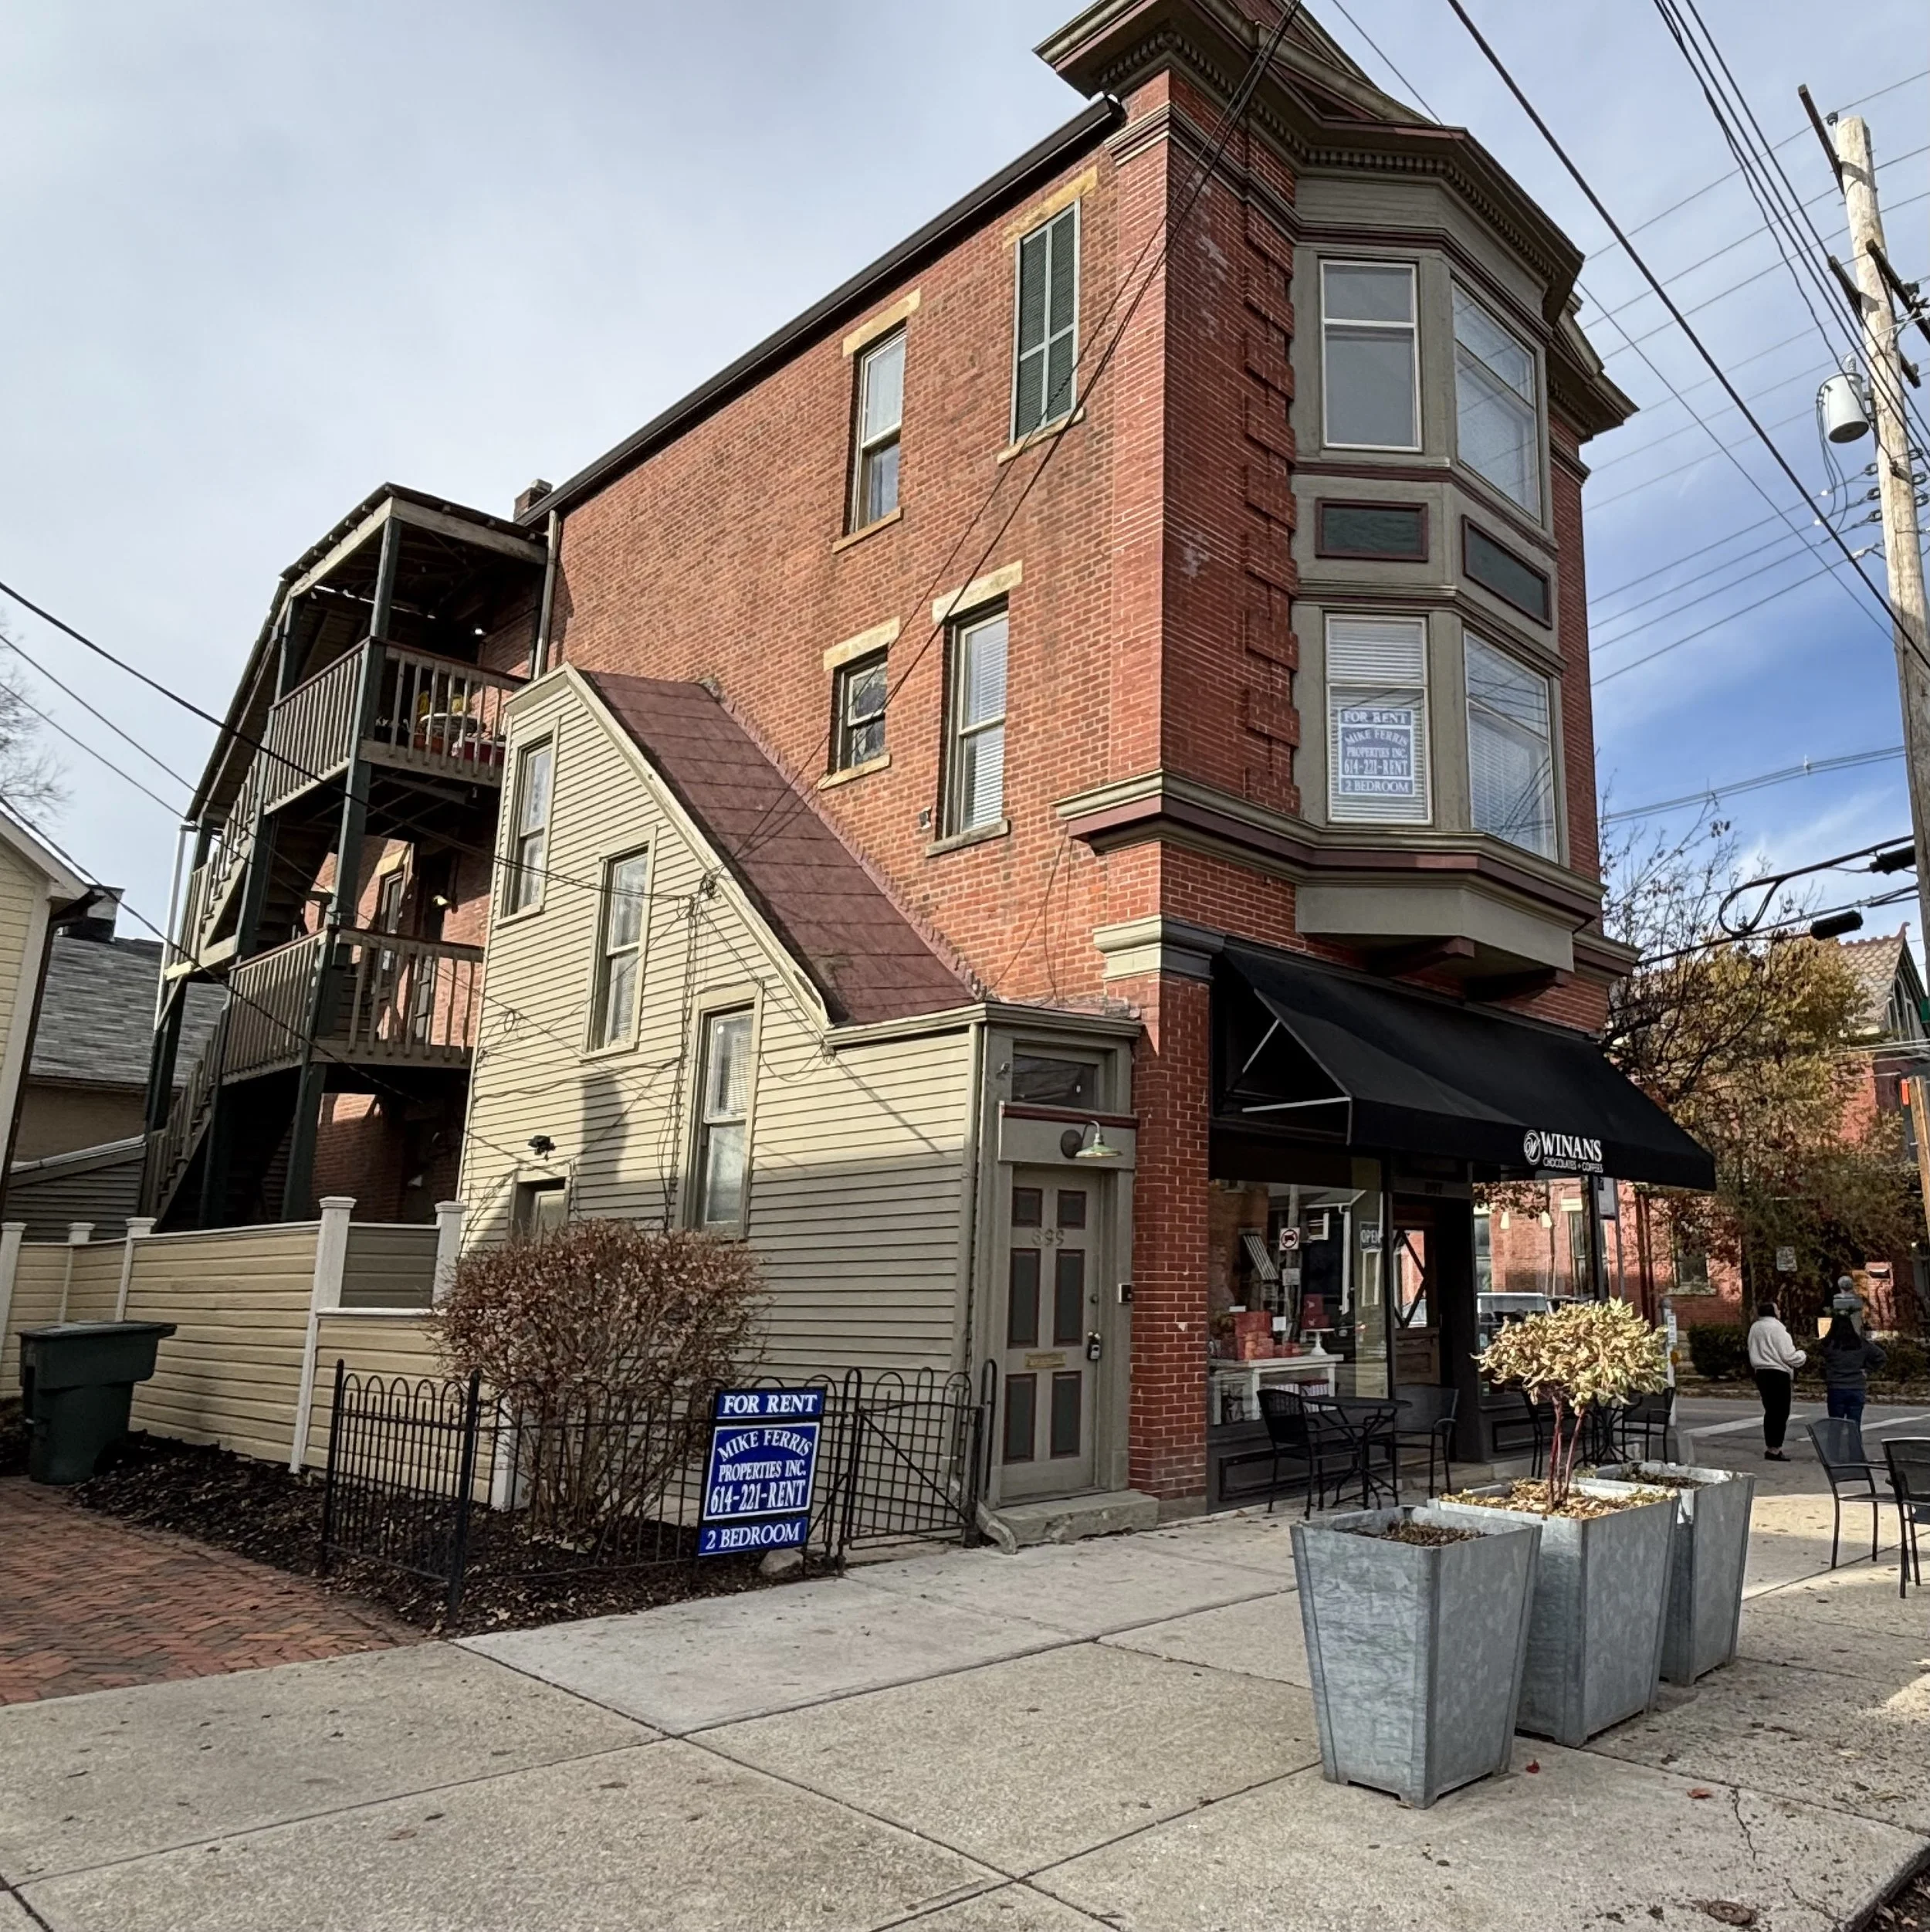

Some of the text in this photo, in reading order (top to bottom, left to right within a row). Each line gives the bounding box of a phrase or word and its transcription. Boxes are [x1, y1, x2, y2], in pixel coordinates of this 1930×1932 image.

[1343, 710, 1407, 724] FOR RENT
[1345, 730, 1408, 746] MIKE FERRIS
[1347, 747, 1407, 758] PROPERTIES INC.
[1344, 759, 1408, 775] 614-221-RENT
[1345, 780, 1409, 792] 2 BEDROOM
[1540, 1131, 1602, 1162] WINANS
[1361, 1229, 1381, 1244] OPEN
[723, 1394, 818, 1414] FOR RENT
[717, 1429, 813, 1462] MIKE FERRIS
[718, 1459, 807, 1482] PROPERTIES INC.
[711, 1480, 806, 1513] 614-221-RENT
[706, 1522, 801, 1550] 2 BEDROOM
